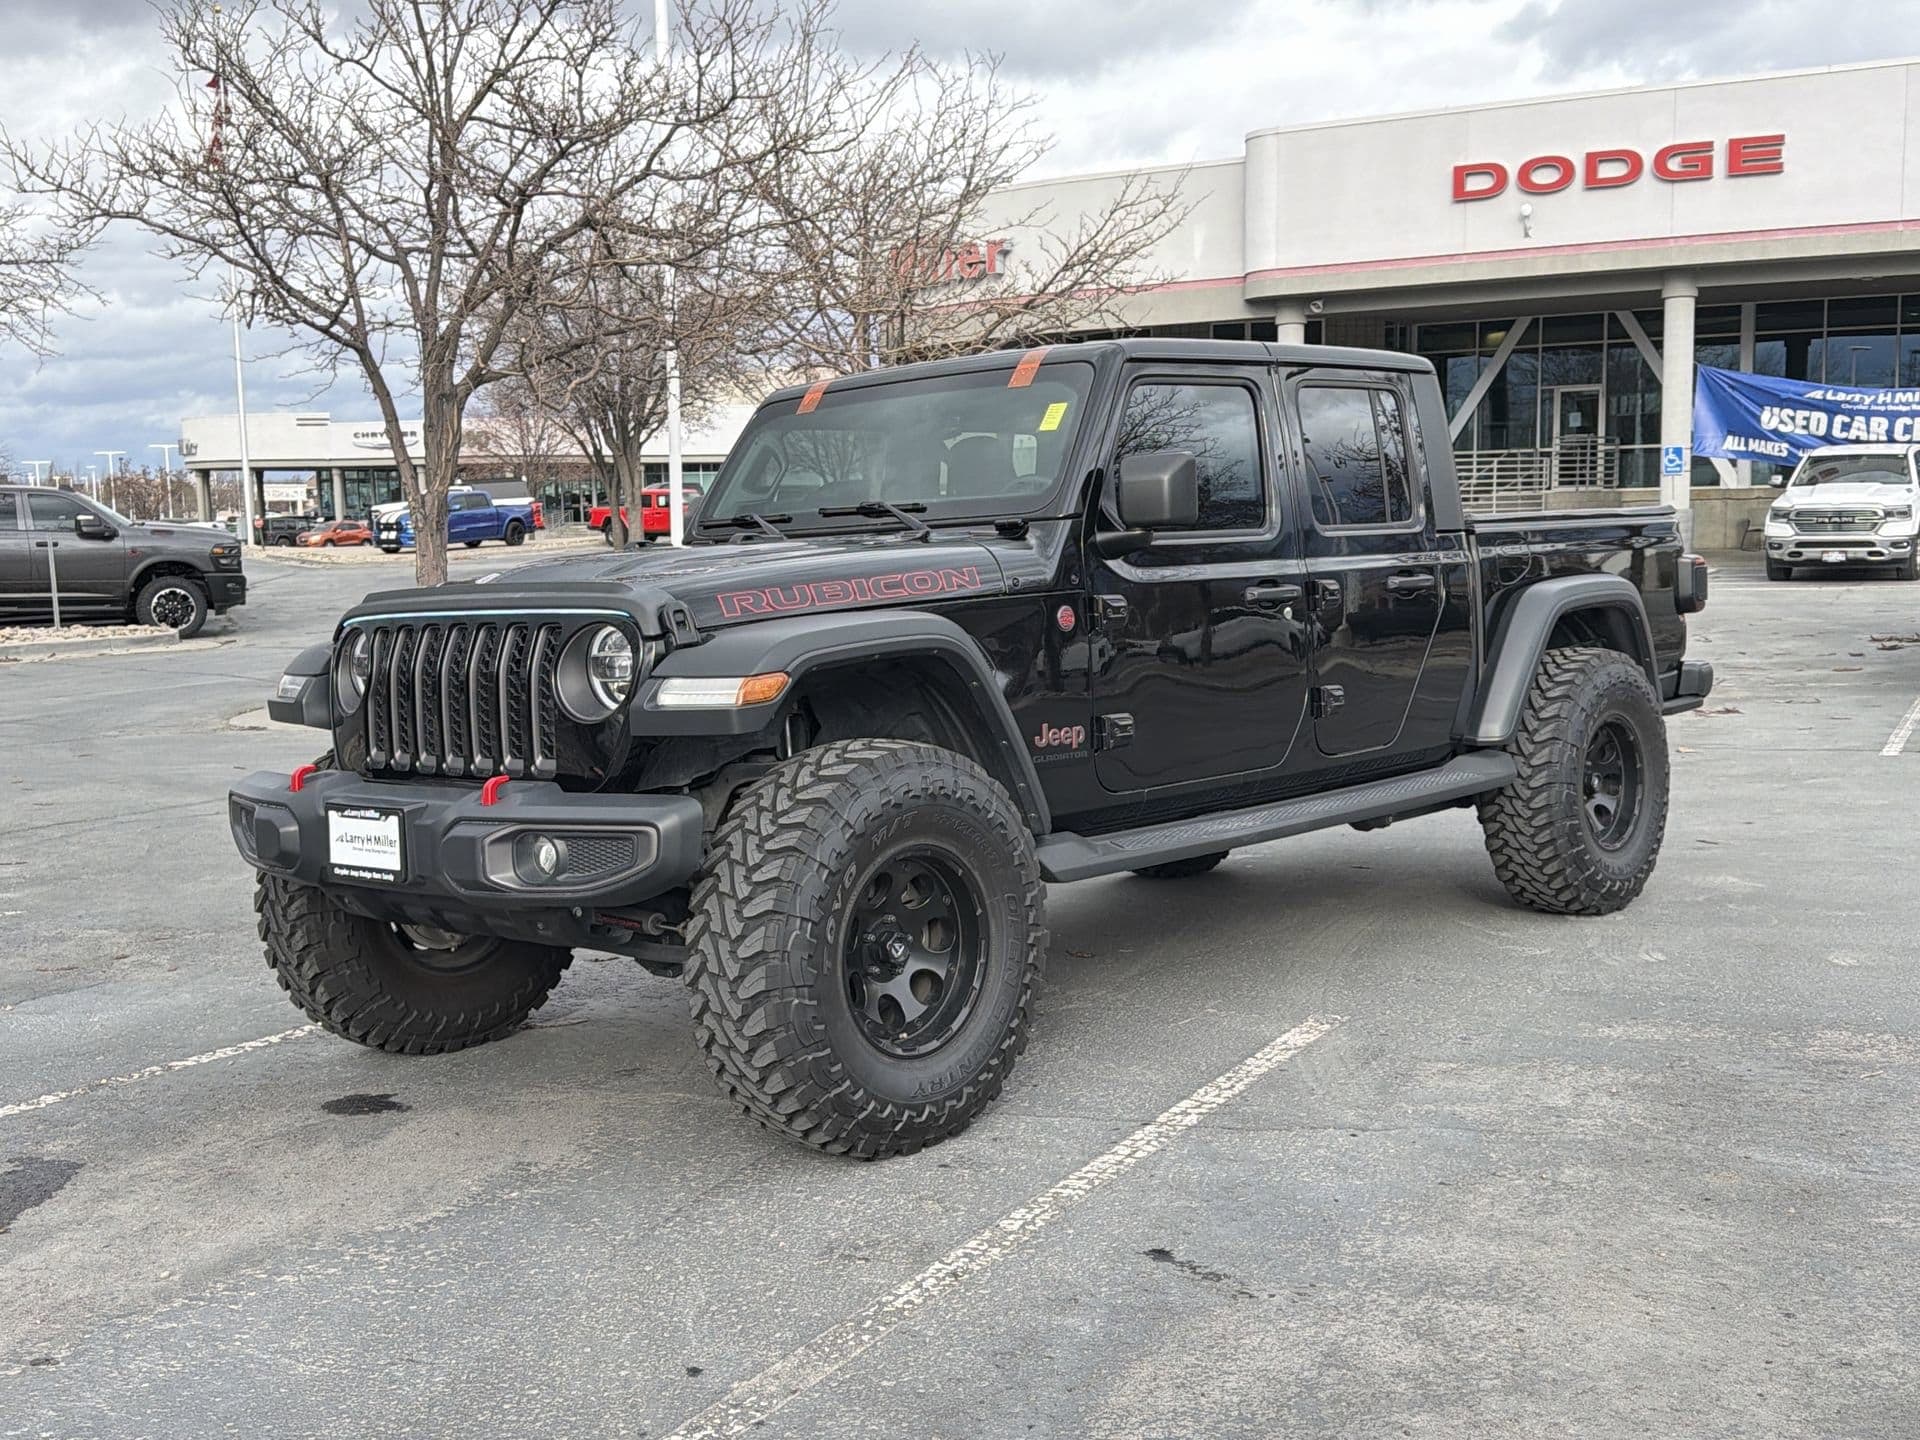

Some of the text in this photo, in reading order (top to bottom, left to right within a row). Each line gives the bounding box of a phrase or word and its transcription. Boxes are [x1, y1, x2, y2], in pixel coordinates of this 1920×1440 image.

[1453, 134, 1786, 203] DODGE
[1826, 389, 1876, 405] Larry
[1877, 391, 1892, 404] H
[353, 431, 417, 439] CHRYER
[1760, 406, 1828, 437] USED
[1831, 414, 1889, 442] CAR
[1722, 435, 1747, 451] ALL
[1748, 437, 1790, 458] MAKES
[717, 566, 981, 618] RUBICON
[1034, 722, 1086, 749] Jeep
[1032, 750, 1088, 763] GLADIATOR
[344, 832, 397, 848] Larry H Miller
